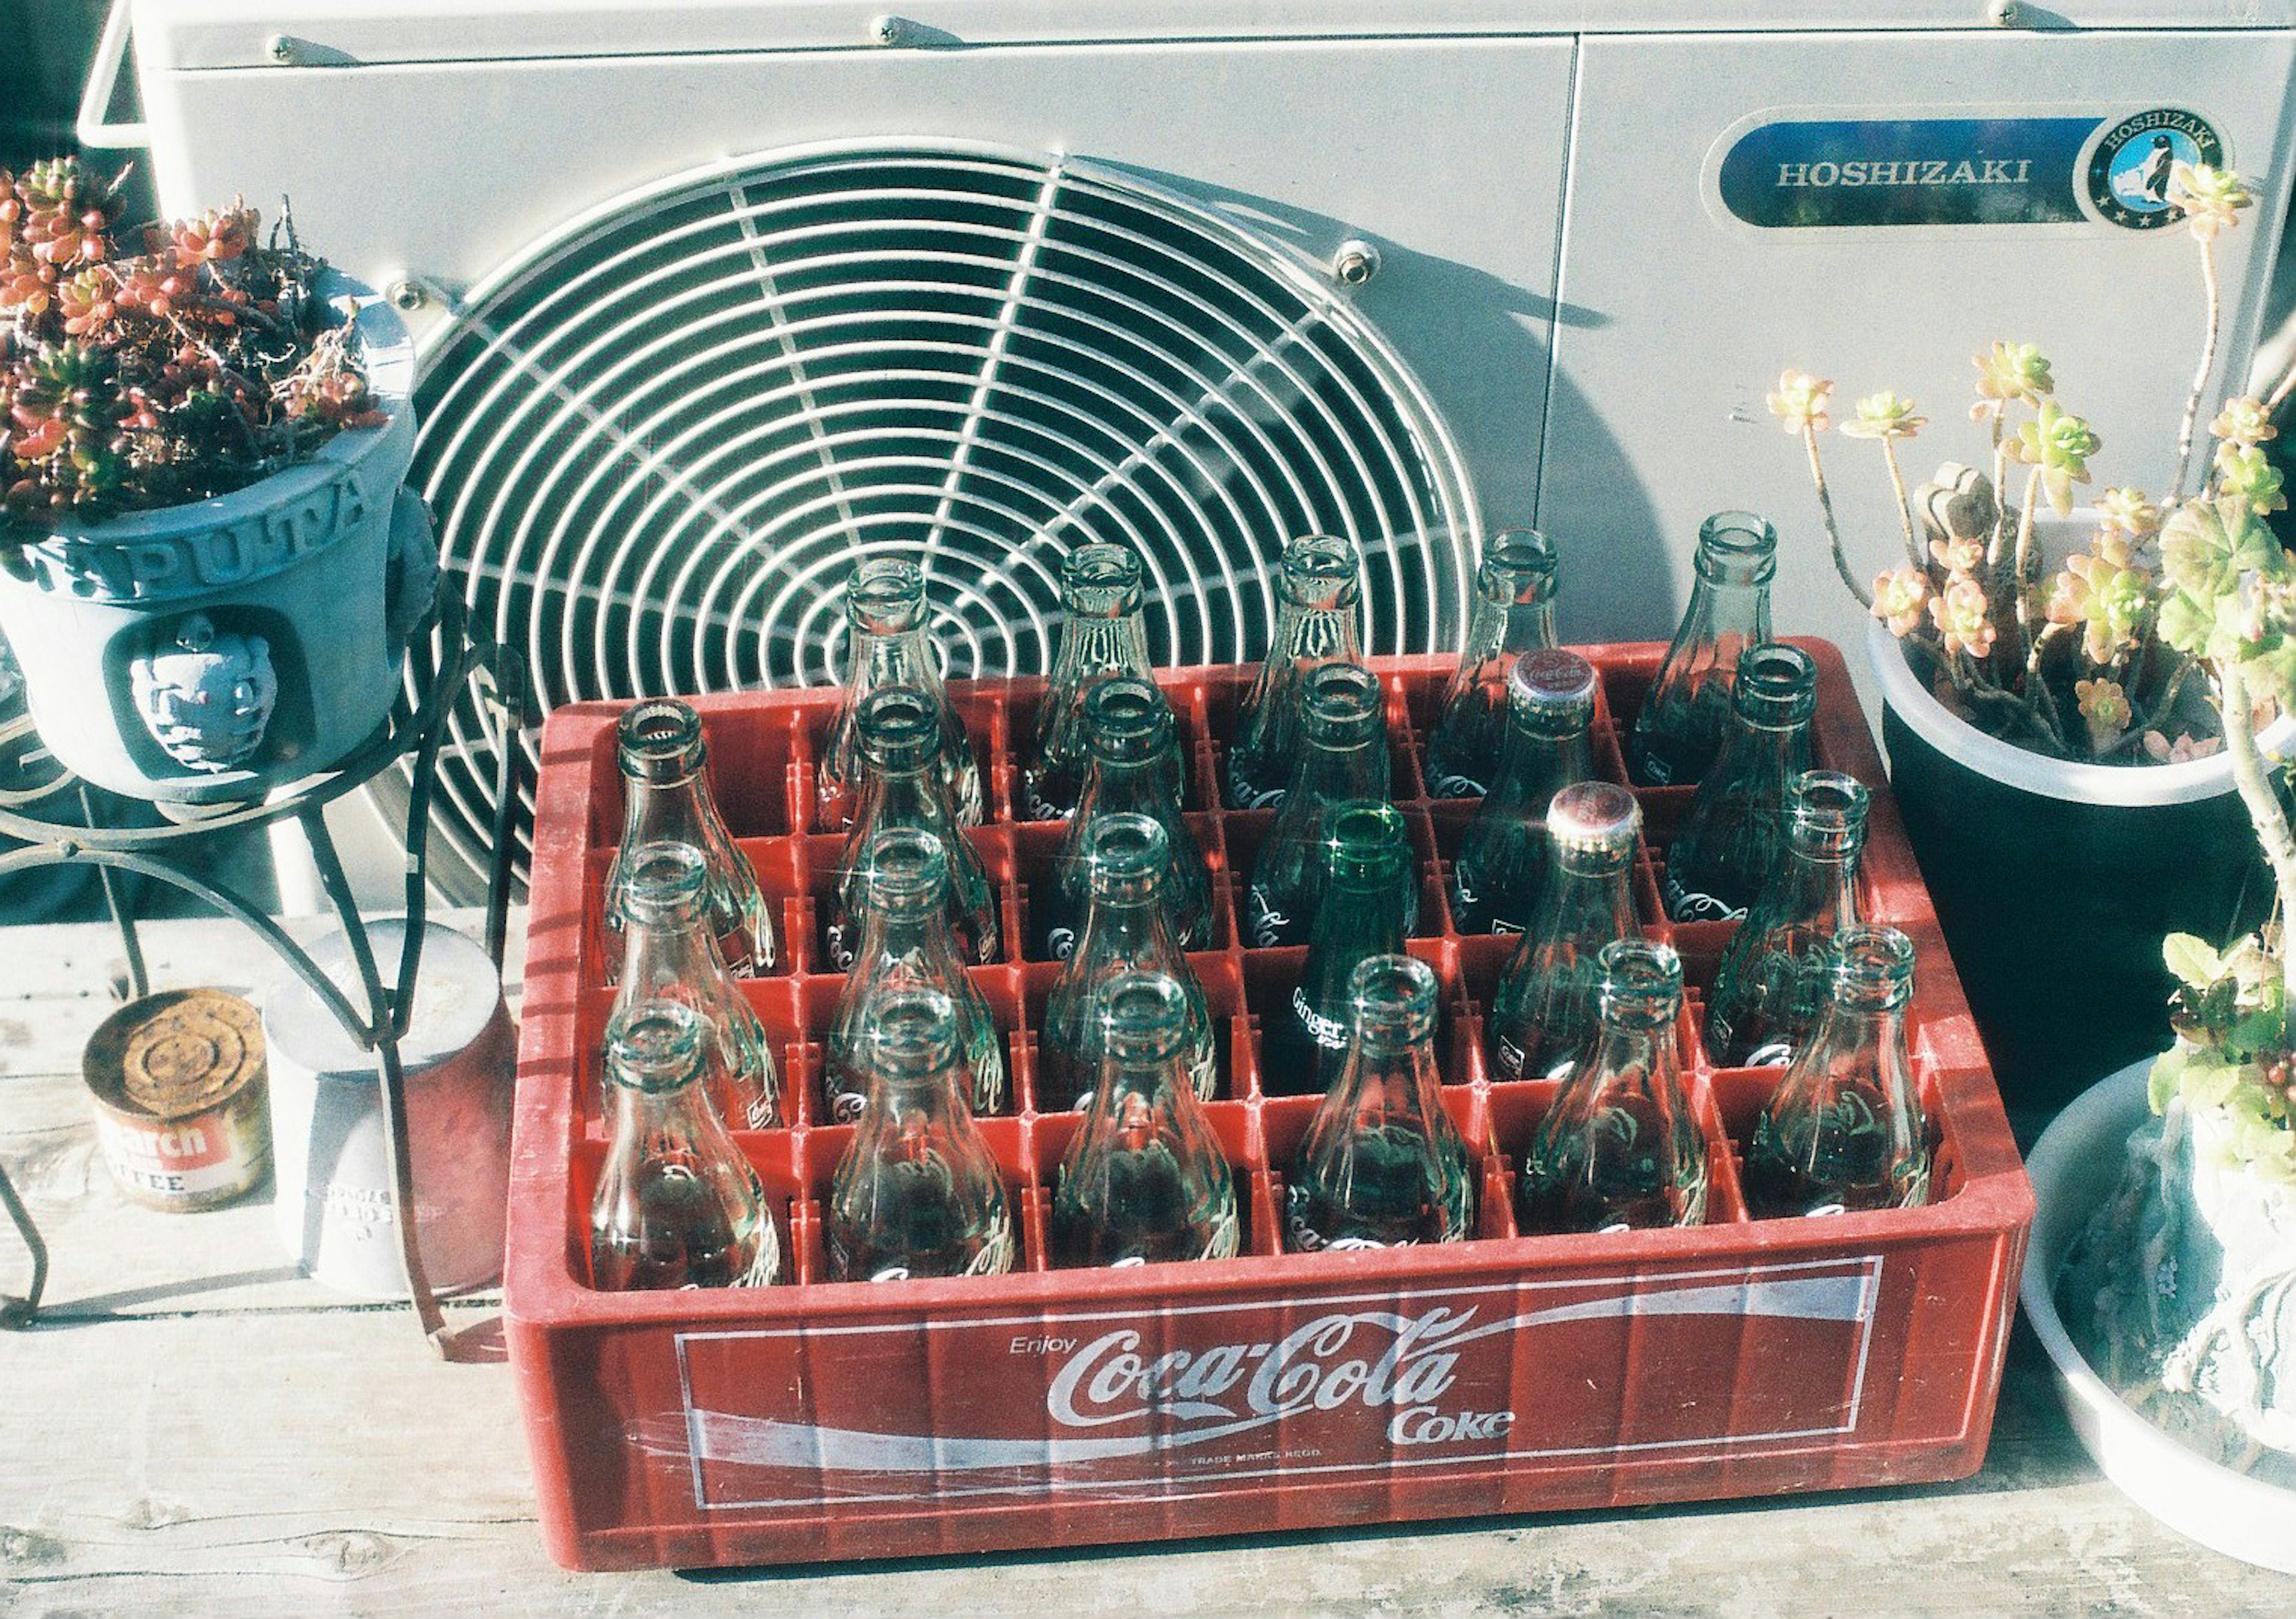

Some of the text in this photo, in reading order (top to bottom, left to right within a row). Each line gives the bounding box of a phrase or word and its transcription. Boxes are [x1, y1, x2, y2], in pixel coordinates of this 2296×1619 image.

[2103, 111, 2217, 151] HOSHIZAKI
[1775, 159, 2032, 188] HOSHIZAKI
[1292, 986, 1345, 1037] Ginger
[1009, 1335, 1077, 1357] Enjoy
[1048, 1304, 1479, 1427] Coca-Cola
[1387, 1406, 1516, 1445] Coke
[1190, 1455, 1232, 1465] TRADE
